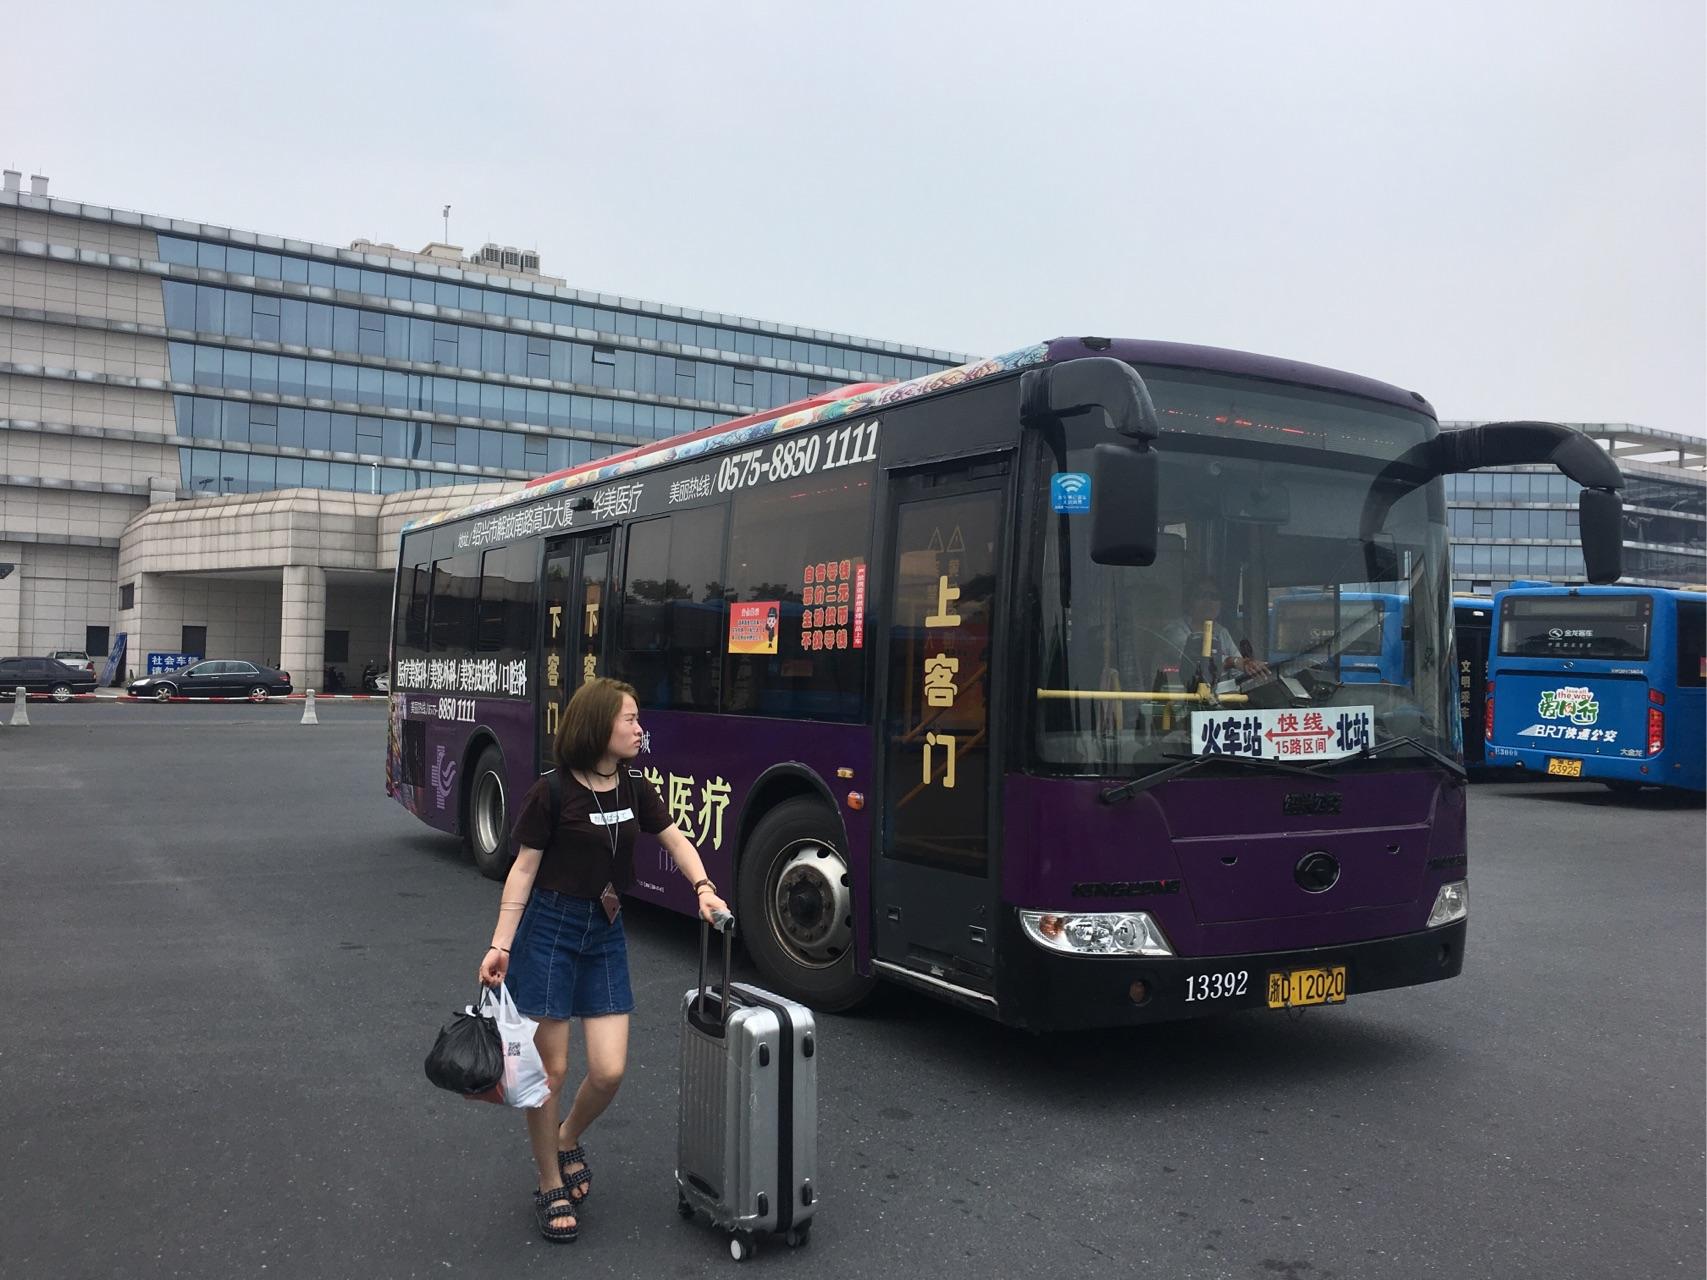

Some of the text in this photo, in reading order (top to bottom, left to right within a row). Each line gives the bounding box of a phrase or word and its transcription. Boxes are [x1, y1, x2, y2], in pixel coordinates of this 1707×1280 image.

[591, 482, 644, 521] 华美医疗
[547, 606, 562, 735] 下客门
[923, 576, 961, 788] 上客门
[1558, 691, 1572, 699] the
[1201, 716, 1262, 756] 火车站
[1277, 713, 1323, 732] 快线
[1336, 712, 1369, 751] 北站
[1275, 738, 1327, 755] 15路区间
[1550, 764, 1579, 776] 23925
[1185, 971, 1249, 1002] 13392
